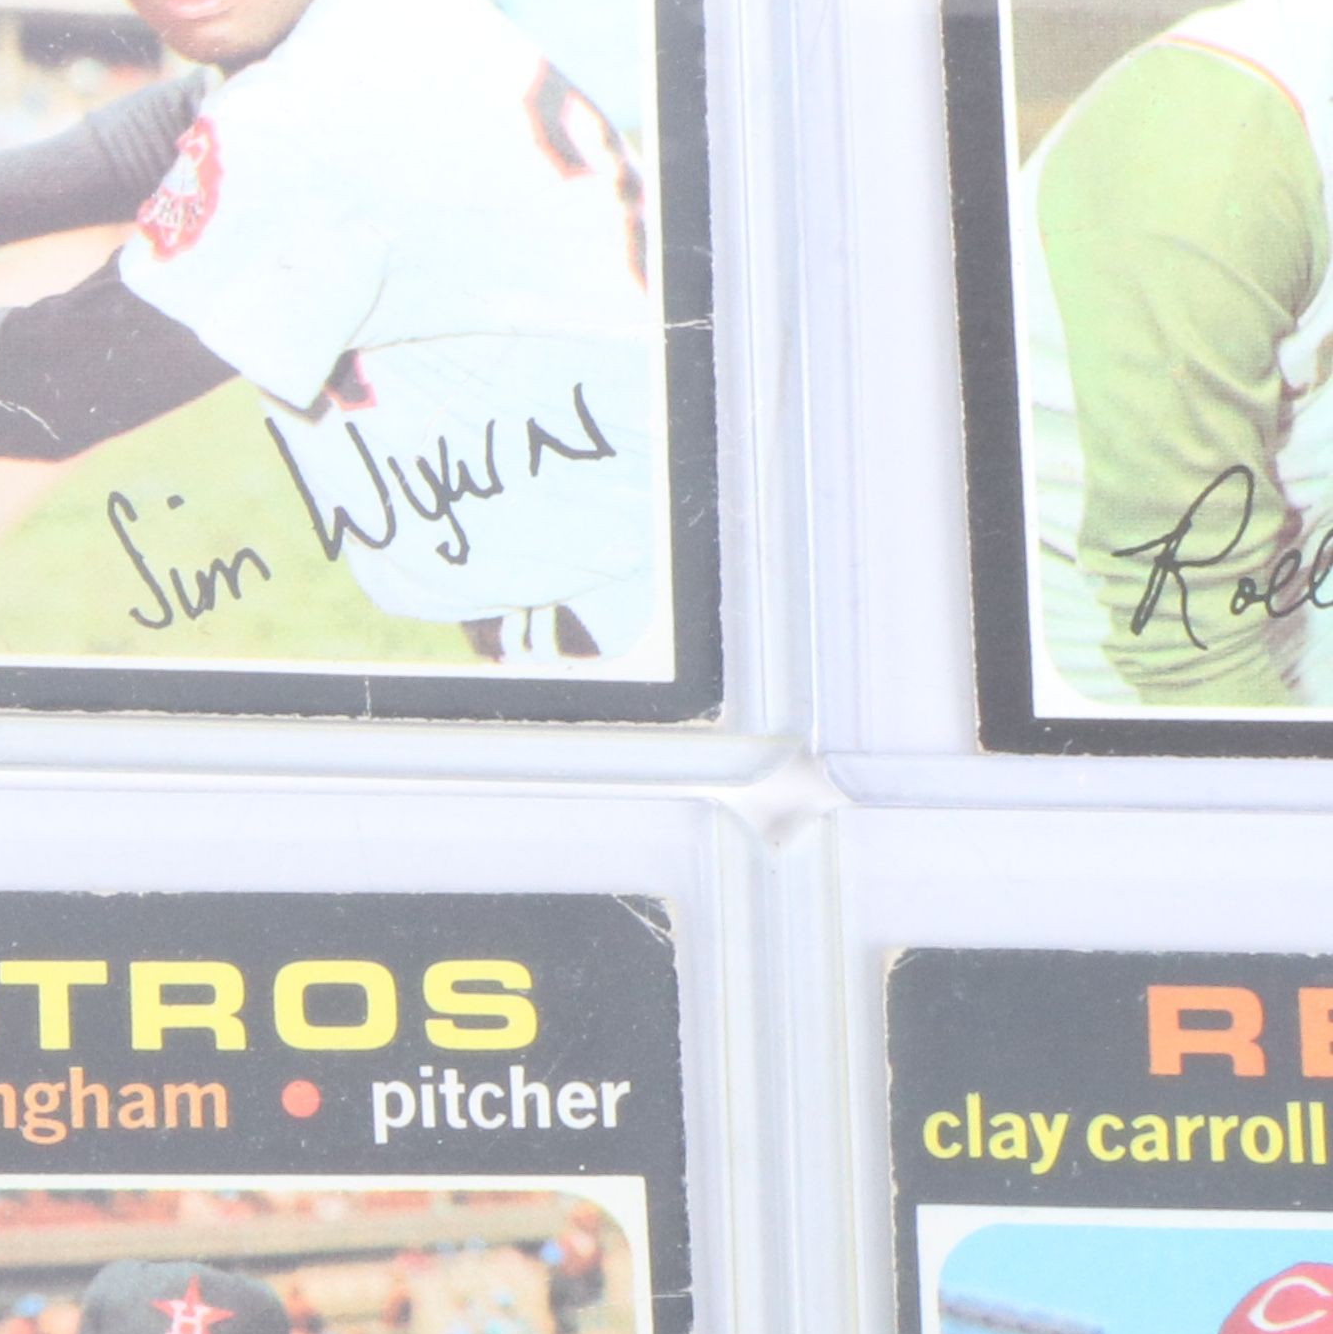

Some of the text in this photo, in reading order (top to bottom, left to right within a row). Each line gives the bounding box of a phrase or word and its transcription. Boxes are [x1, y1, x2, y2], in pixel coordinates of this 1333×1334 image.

[372, 1069, 630, 1144] pitcher
[923, 1092, 1328, 1174] clay carroll
[1246, 1274, 1333, 1333] C
